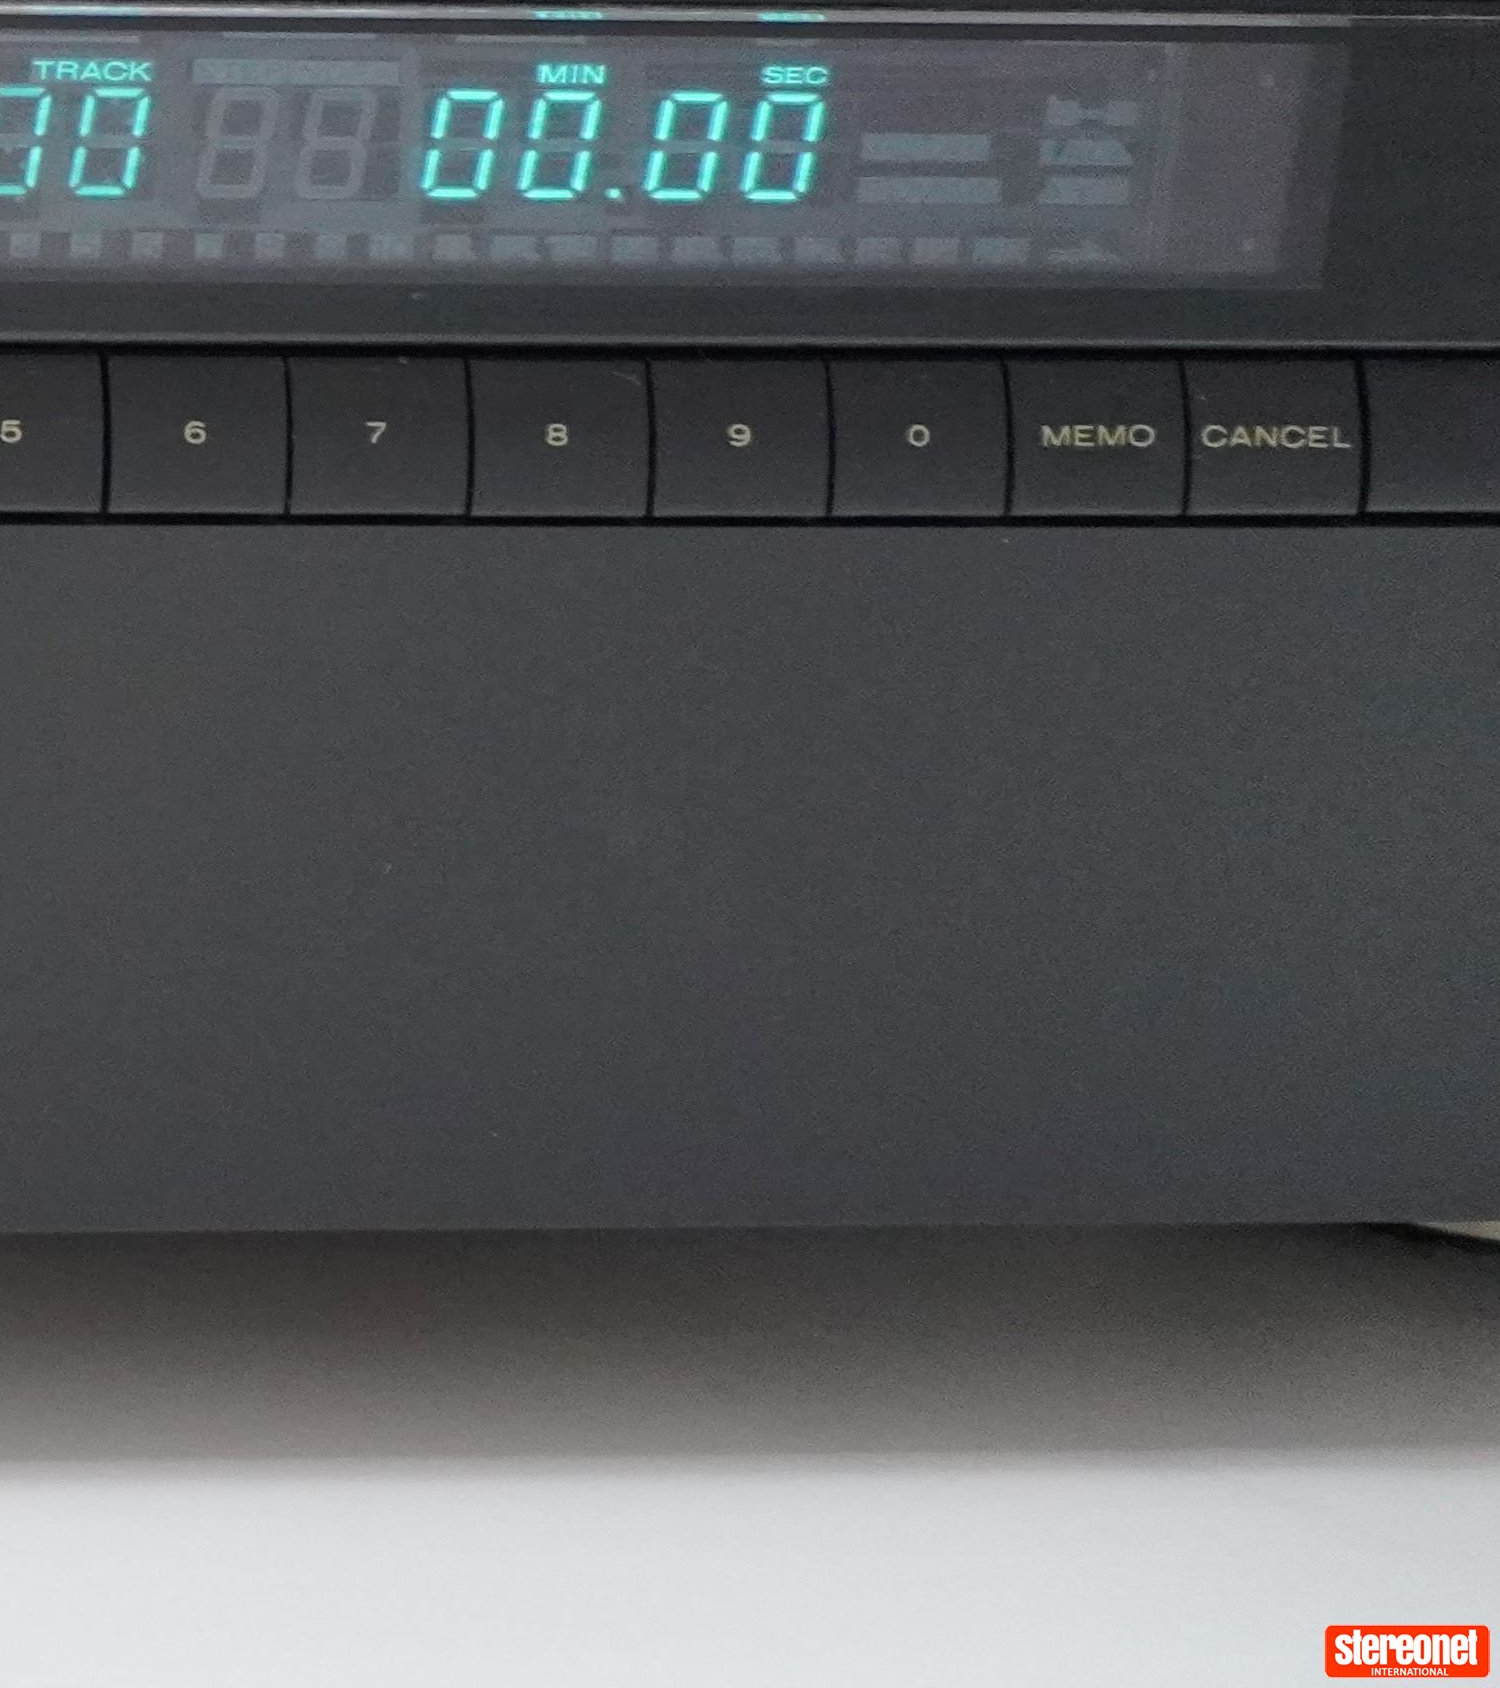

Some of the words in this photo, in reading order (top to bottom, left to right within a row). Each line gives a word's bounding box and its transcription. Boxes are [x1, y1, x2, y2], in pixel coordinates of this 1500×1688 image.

[33, 60, 151, 82] TRACK
[537, 64, 605, 85] MIN
[762, 65, 828, 85] SEC
[0, 419, 23, 444] 5
[183, 420, 207, 445] 6
[366, 421, 387, 444] 7
[545, 423, 569, 447] 8
[727, 423, 752, 448] 9
[1041, 423, 1156, 448] MEMO
[1200, 424, 1352, 449] CANCEL
